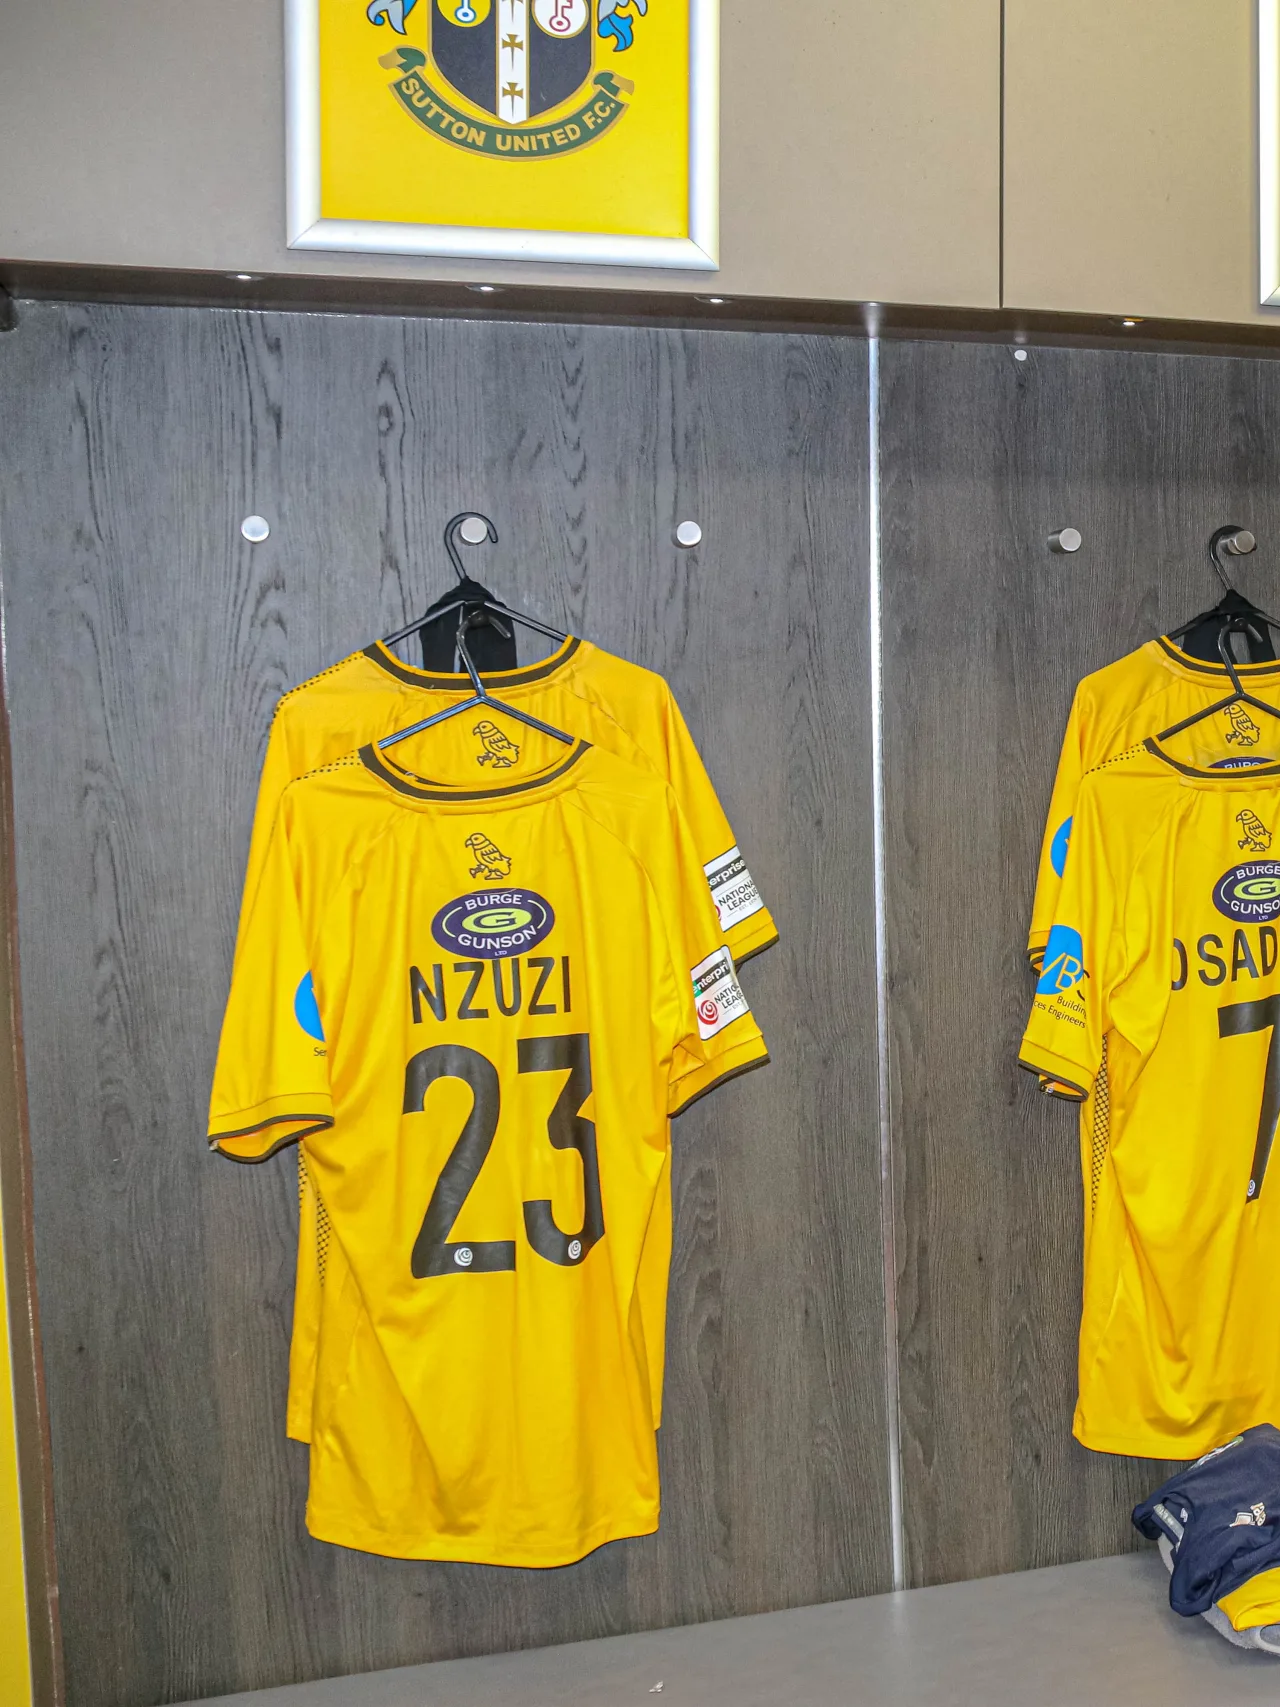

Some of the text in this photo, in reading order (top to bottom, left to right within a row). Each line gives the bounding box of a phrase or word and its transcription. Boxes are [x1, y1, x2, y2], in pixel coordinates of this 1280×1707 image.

[401, 77, 616, 152] SUTTON UNITED F.C.
[1241, 881, 1279, 896] G
[464, 893, 523, 911] BURGE
[473, 911, 518, 929] G
[457, 925, 538, 950] GUNSON
[409, 955, 572, 1025] NZUZI
[1047, 1004, 1086, 1029] Engineers
[402, 1032, 606, 1280] 23
